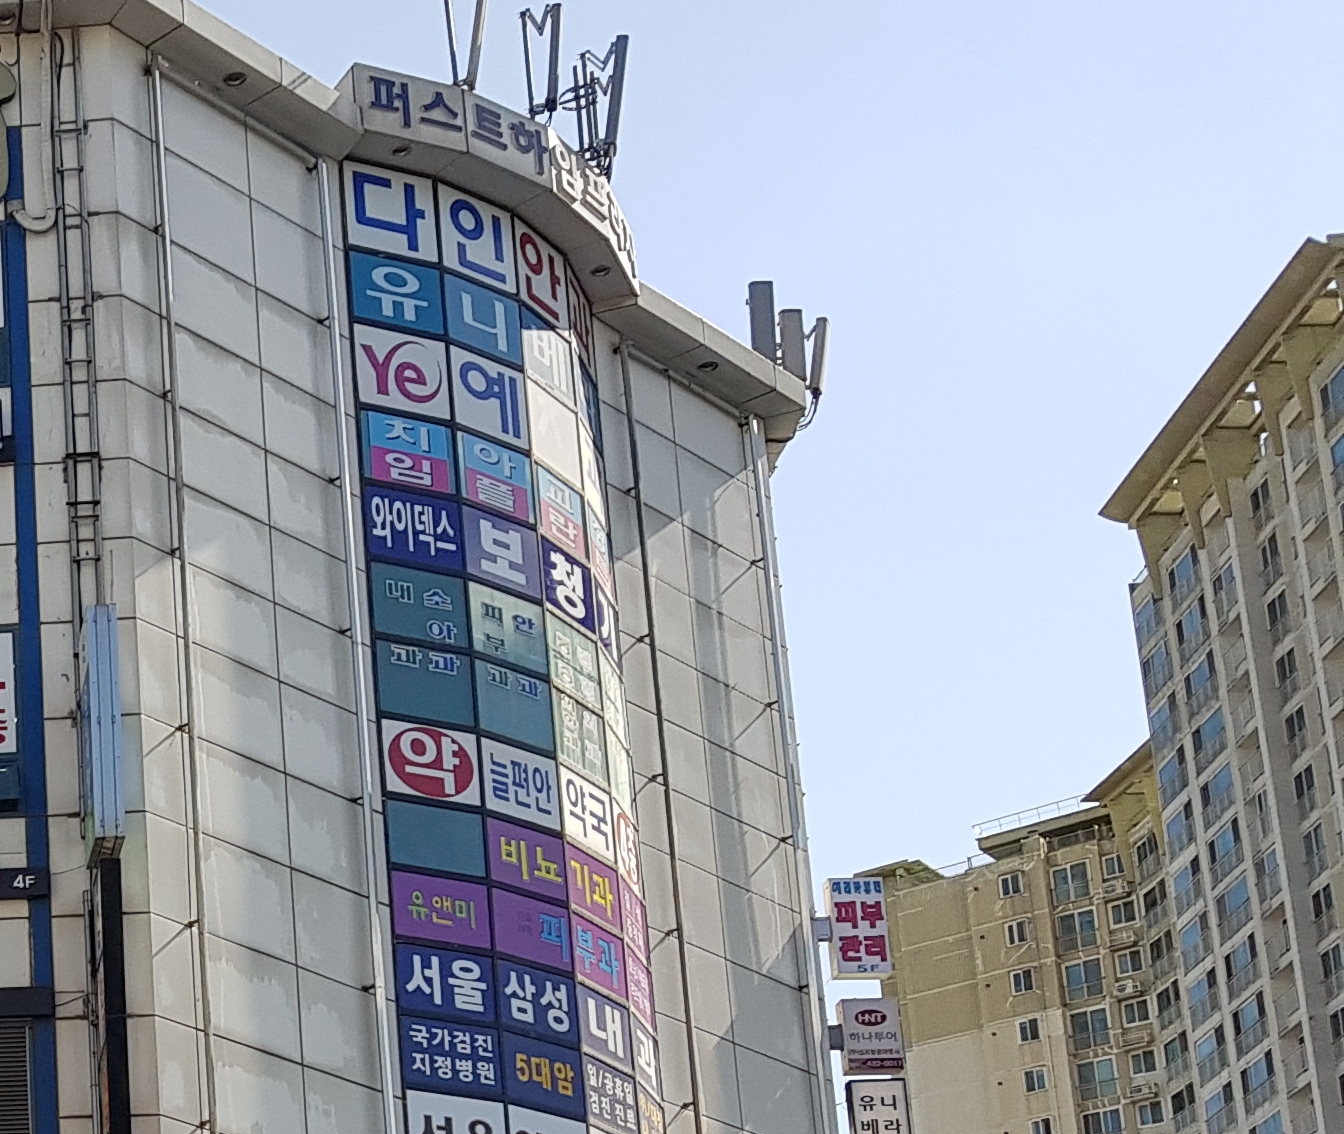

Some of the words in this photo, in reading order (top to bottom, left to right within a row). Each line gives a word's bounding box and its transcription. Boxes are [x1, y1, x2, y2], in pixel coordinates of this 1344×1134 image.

[353, 170, 594, 368] 다인안과
[371, 494, 458, 556] 와이덱스
[399, 730, 462, 796] 약
[12, 872, 36, 890] 4F
[408, 889, 477, 931] 유앤미
[409, 1024, 495, 1058] 국가검진
[849, 1031, 898, 1043] 하나투어
[412, 1052, 496, 1087] 지정병원
[515, 1052, 575, 1098] 5대암
